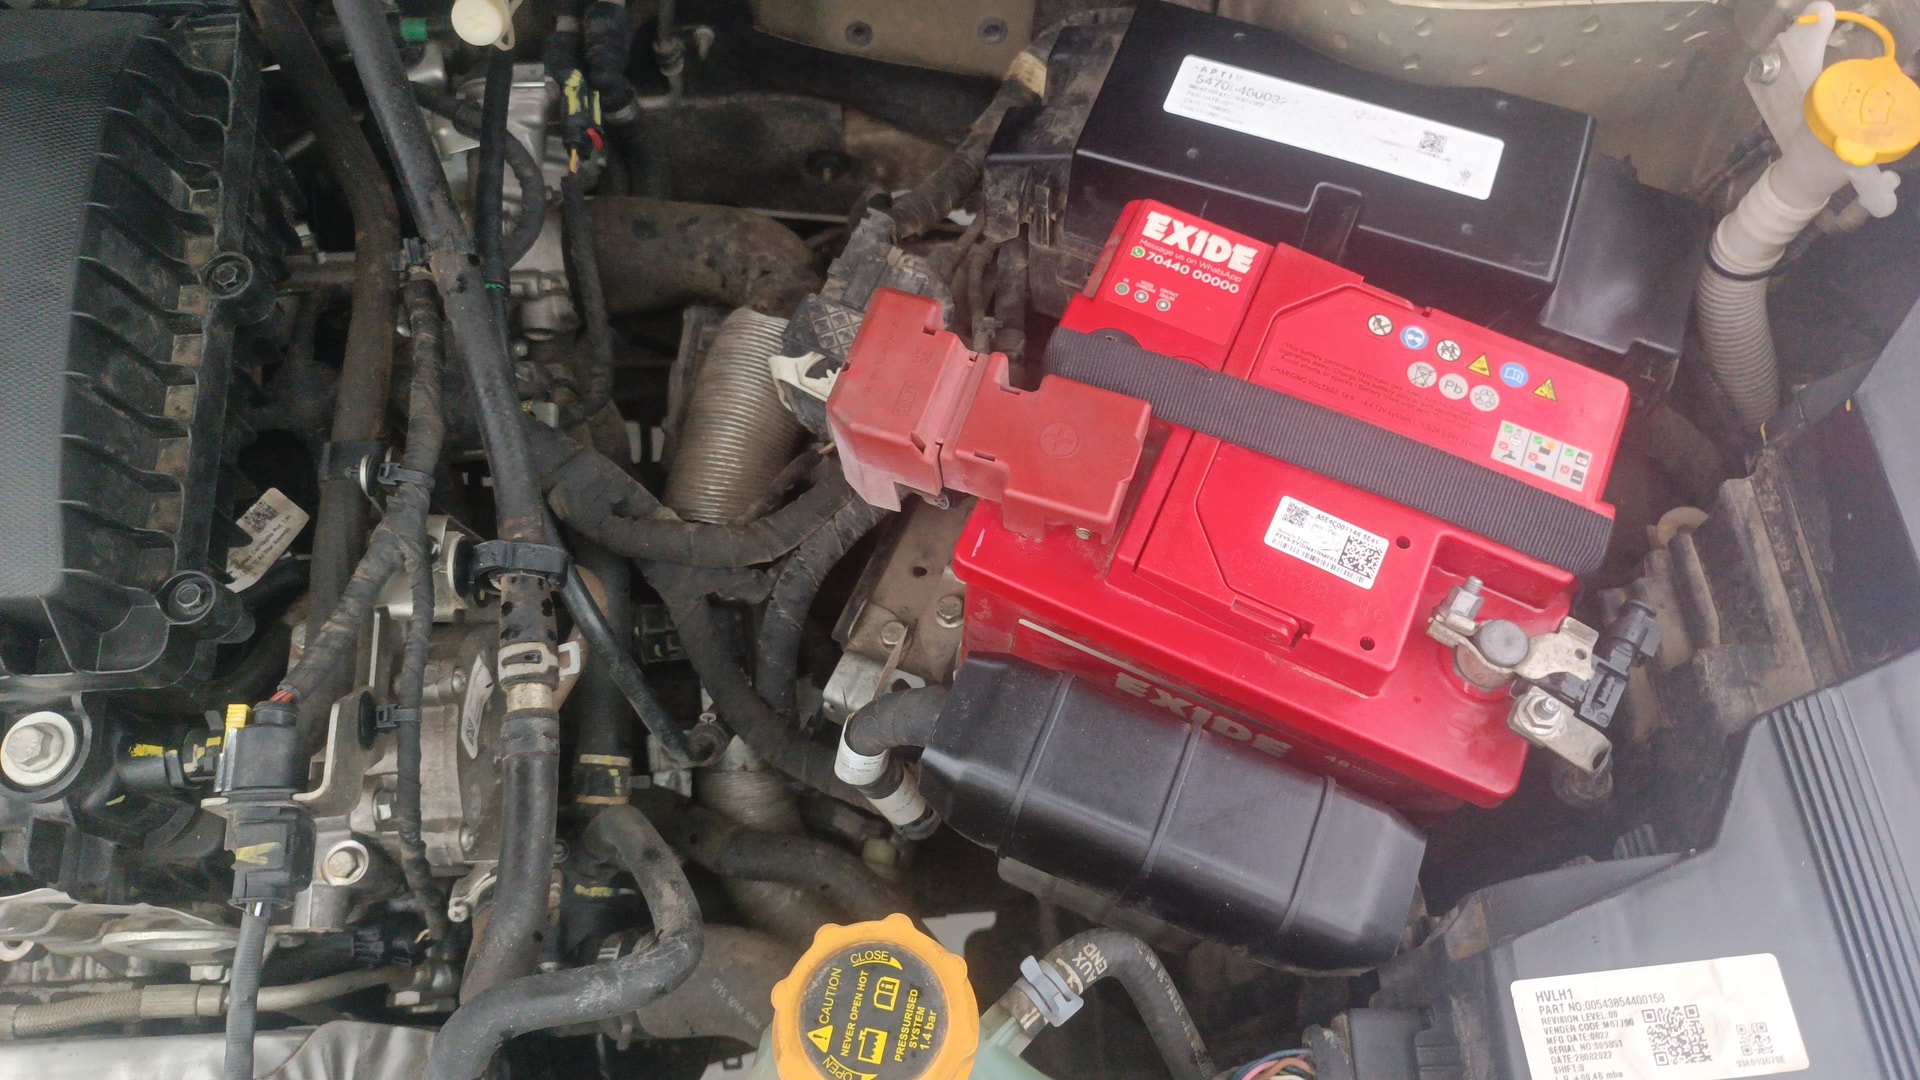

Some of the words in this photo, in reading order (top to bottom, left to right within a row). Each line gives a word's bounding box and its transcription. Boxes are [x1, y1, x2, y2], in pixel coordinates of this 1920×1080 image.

[1142, 211, 1258, 274] EXIDE
[1139, 238, 1174, 257] Message
[1175, 252, 1185, 261] us
[1186, 256, 1197, 265] on
[1199, 260, 1242, 283] WhatsApp
[1146, 251, 1190, 275] 70440
[1192, 269, 1240, 294] 00000
[1269, 364, 1307, 384] CHARGING
[1306, 378, 1340, 395] VOLTAGE
[1443, 379, 1464, 394] Pb
[1114, 672, 1293, 758] EXIDE
[851, 951, 889, 963] CLOSE
[1072, 951, 1097, 983] AUX
[1083, 942, 1108, 975] END
[819, 967, 843, 1024] CAUTION
[857, 970, 869, 992] HOT
[1535, 987, 1573, 1003] HVLH1
[852, 992, 864, 1021] OPEN
[1538, 1002, 1564, 1015] PART
[1541, 1014, 1578, 1026] REVISION
[840, 1023, 855, 1057] NEVER
[894, 989, 919, 1062] PRESSURISED
[909, 1006, 926, 1049] SYSTEM
[920, 1031, 932, 1050] 1.4
[927, 1010, 938, 1031] bar
[1543, 1024, 1576, 1035] VENDER
[1545, 1035, 1564, 1044] MFG
[1548, 1044, 1576, 1054] SERIAL
[823, 1057, 853, 1080] OPEN
